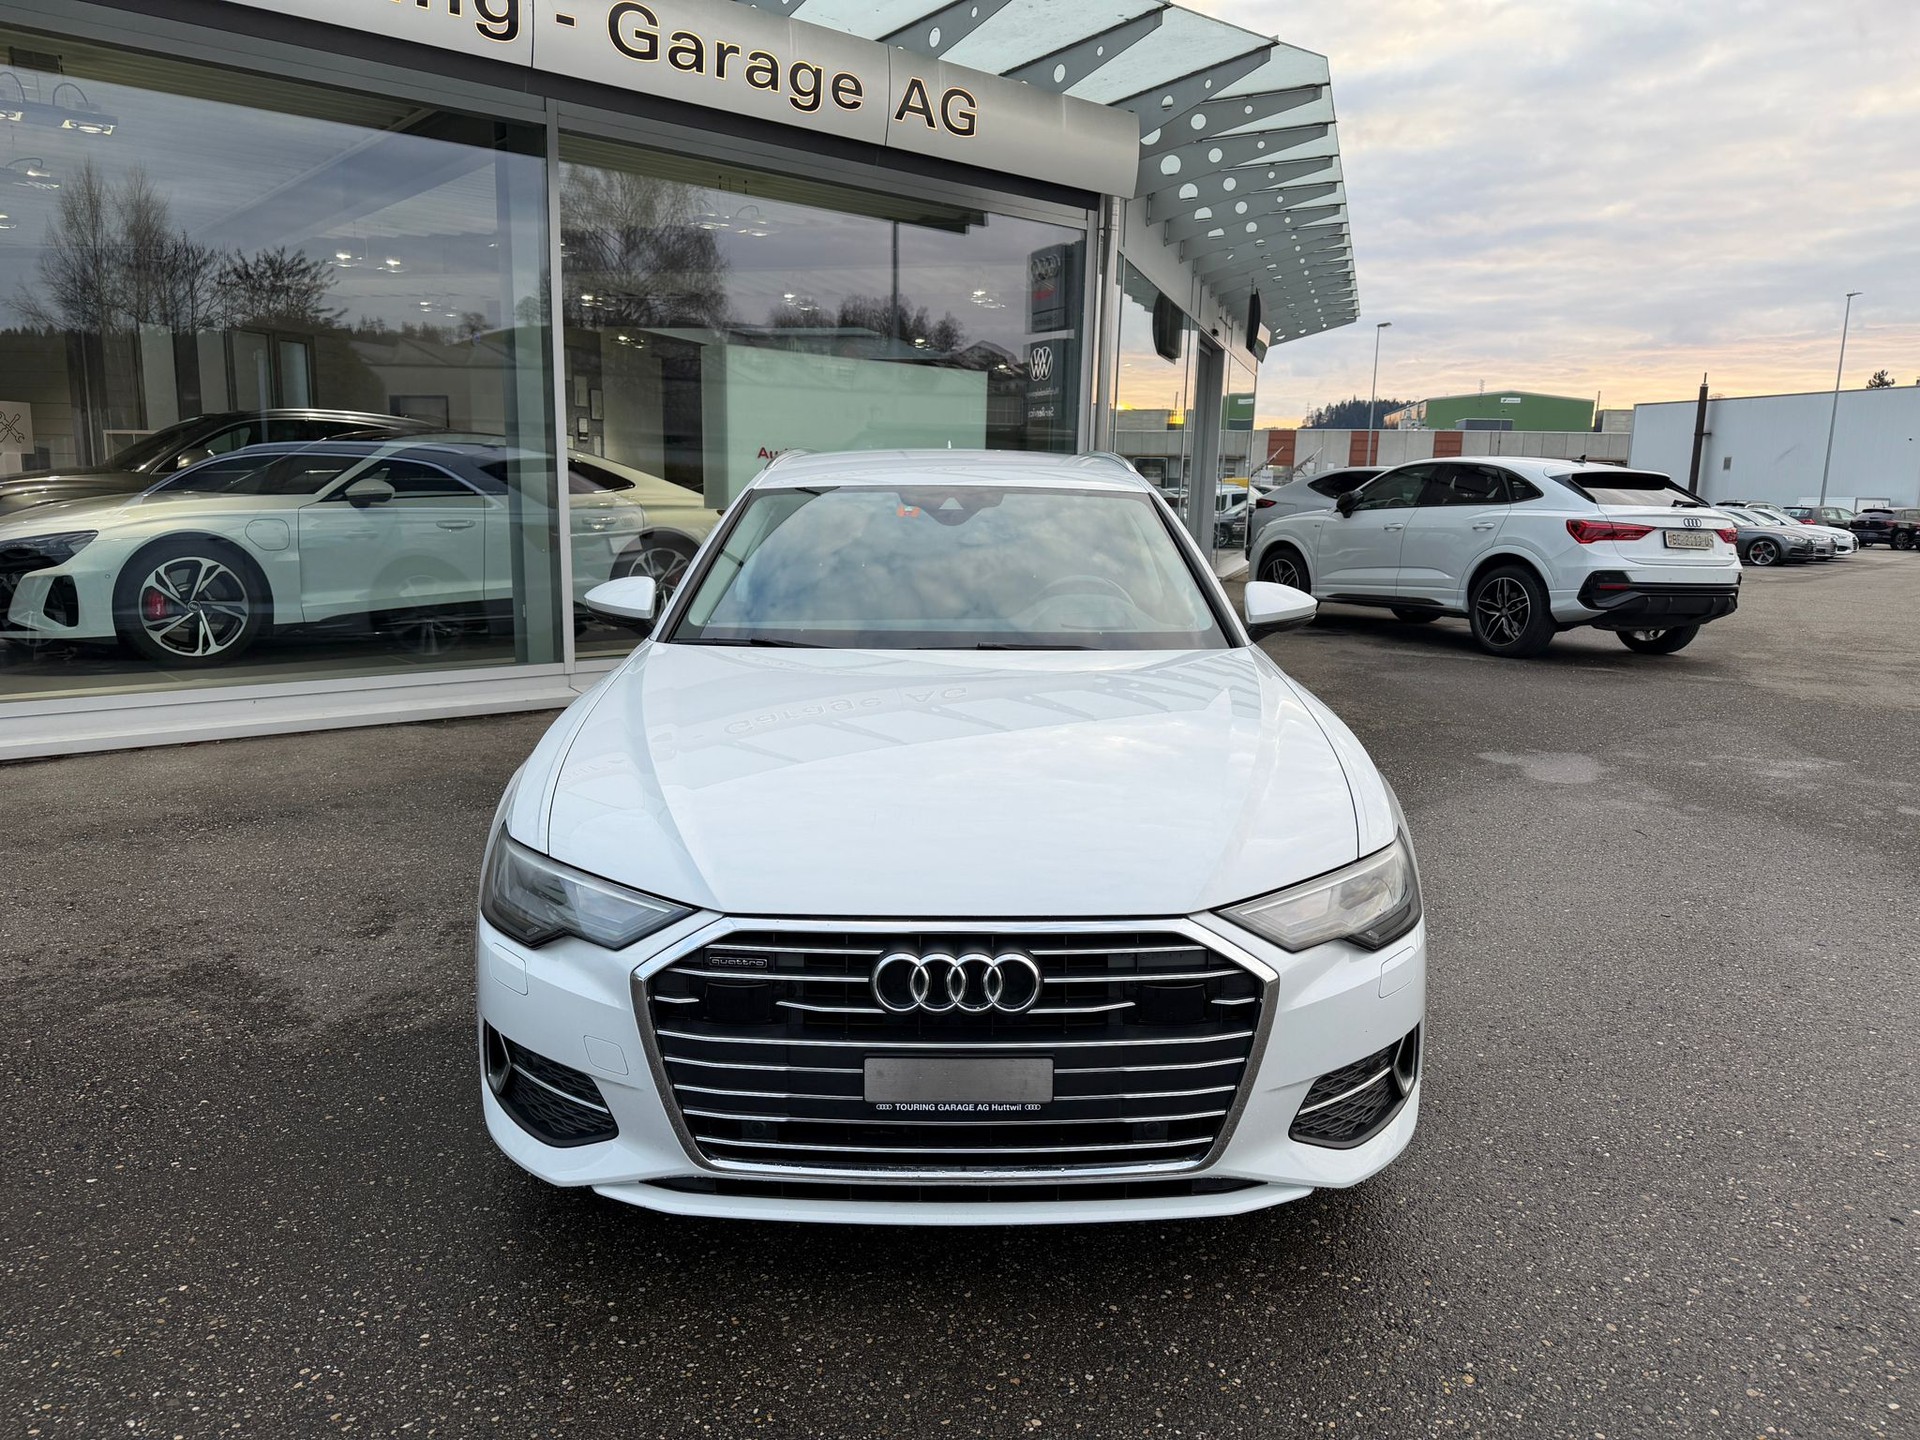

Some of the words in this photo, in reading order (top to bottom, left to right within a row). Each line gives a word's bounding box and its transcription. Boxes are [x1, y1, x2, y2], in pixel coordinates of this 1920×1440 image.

[607, 0, 864, 113] Garage
[893, 76, 978, 138] AG
[711, 958, 765, 966] quattro
[895, 1103, 935, 1111] TOURING
[937, 1103, 975, 1111] GARAGE
[976, 1103, 990, 1111] AG
[991, 1103, 1022, 1111] Huttwil
